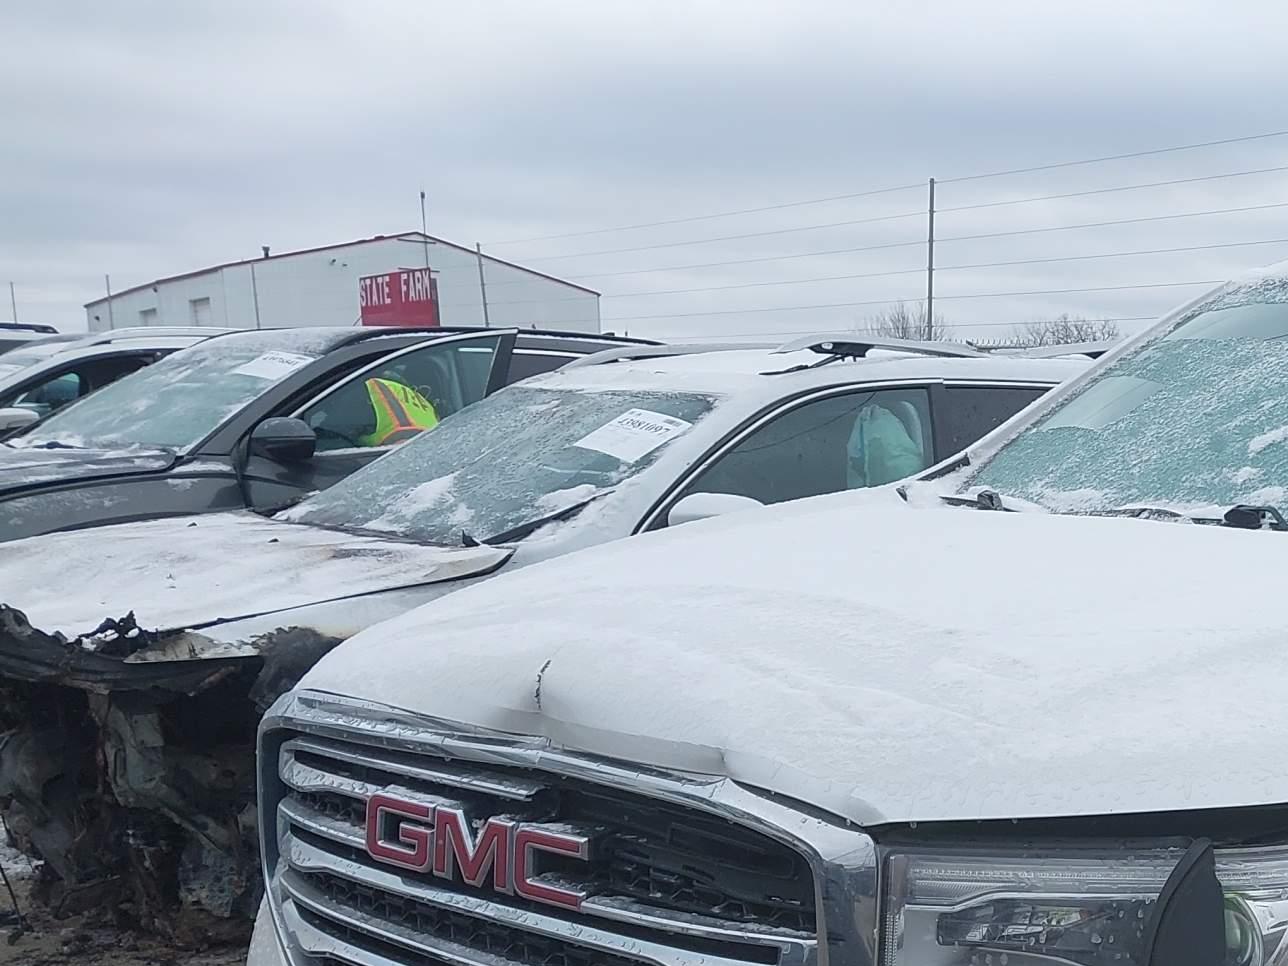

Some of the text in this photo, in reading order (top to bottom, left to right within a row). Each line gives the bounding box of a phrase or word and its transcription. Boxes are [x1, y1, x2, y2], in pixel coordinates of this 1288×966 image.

[360, 269, 431, 307] STATE FARM
[366, 793, 589, 911] GMC
